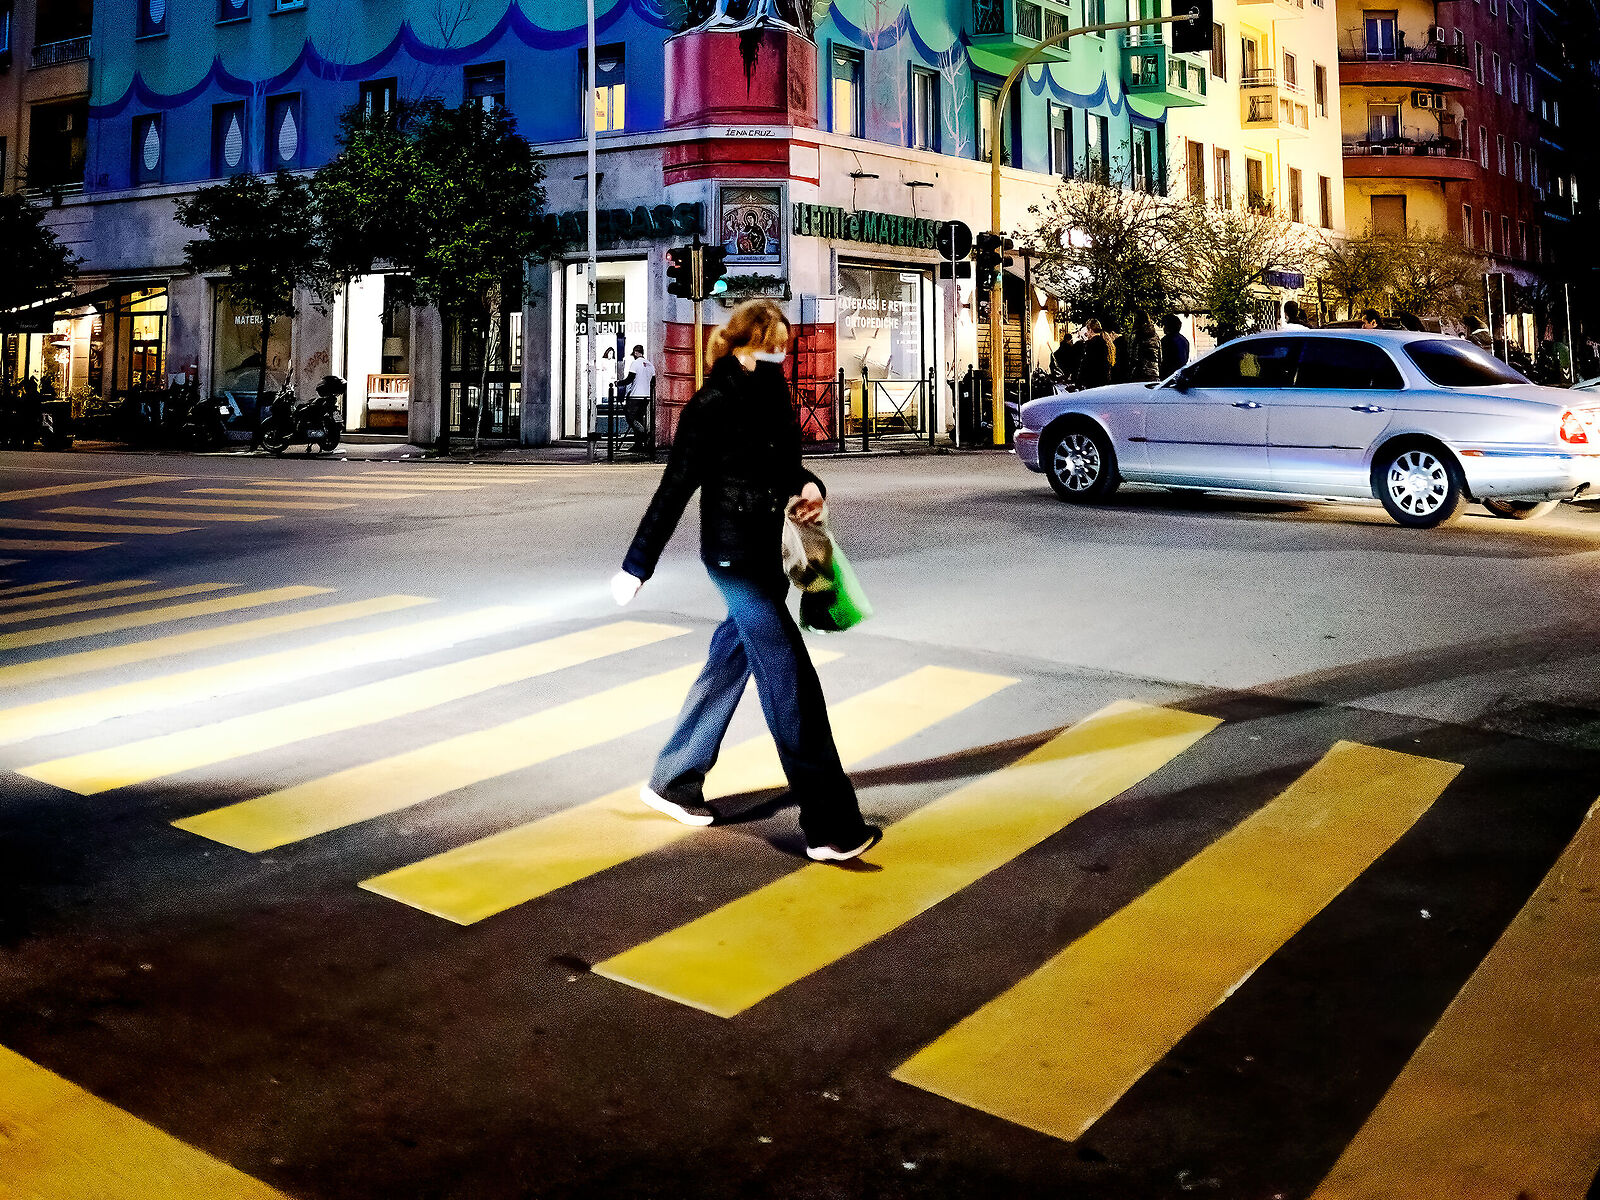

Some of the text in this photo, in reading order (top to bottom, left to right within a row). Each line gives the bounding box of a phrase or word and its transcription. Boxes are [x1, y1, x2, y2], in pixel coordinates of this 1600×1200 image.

[800, 202, 845, 238] LETTI
[845, 213, 860, 240] e
[595, 302, 624, 315] LETTI
[574, 321, 647, 334] COTENITORE
